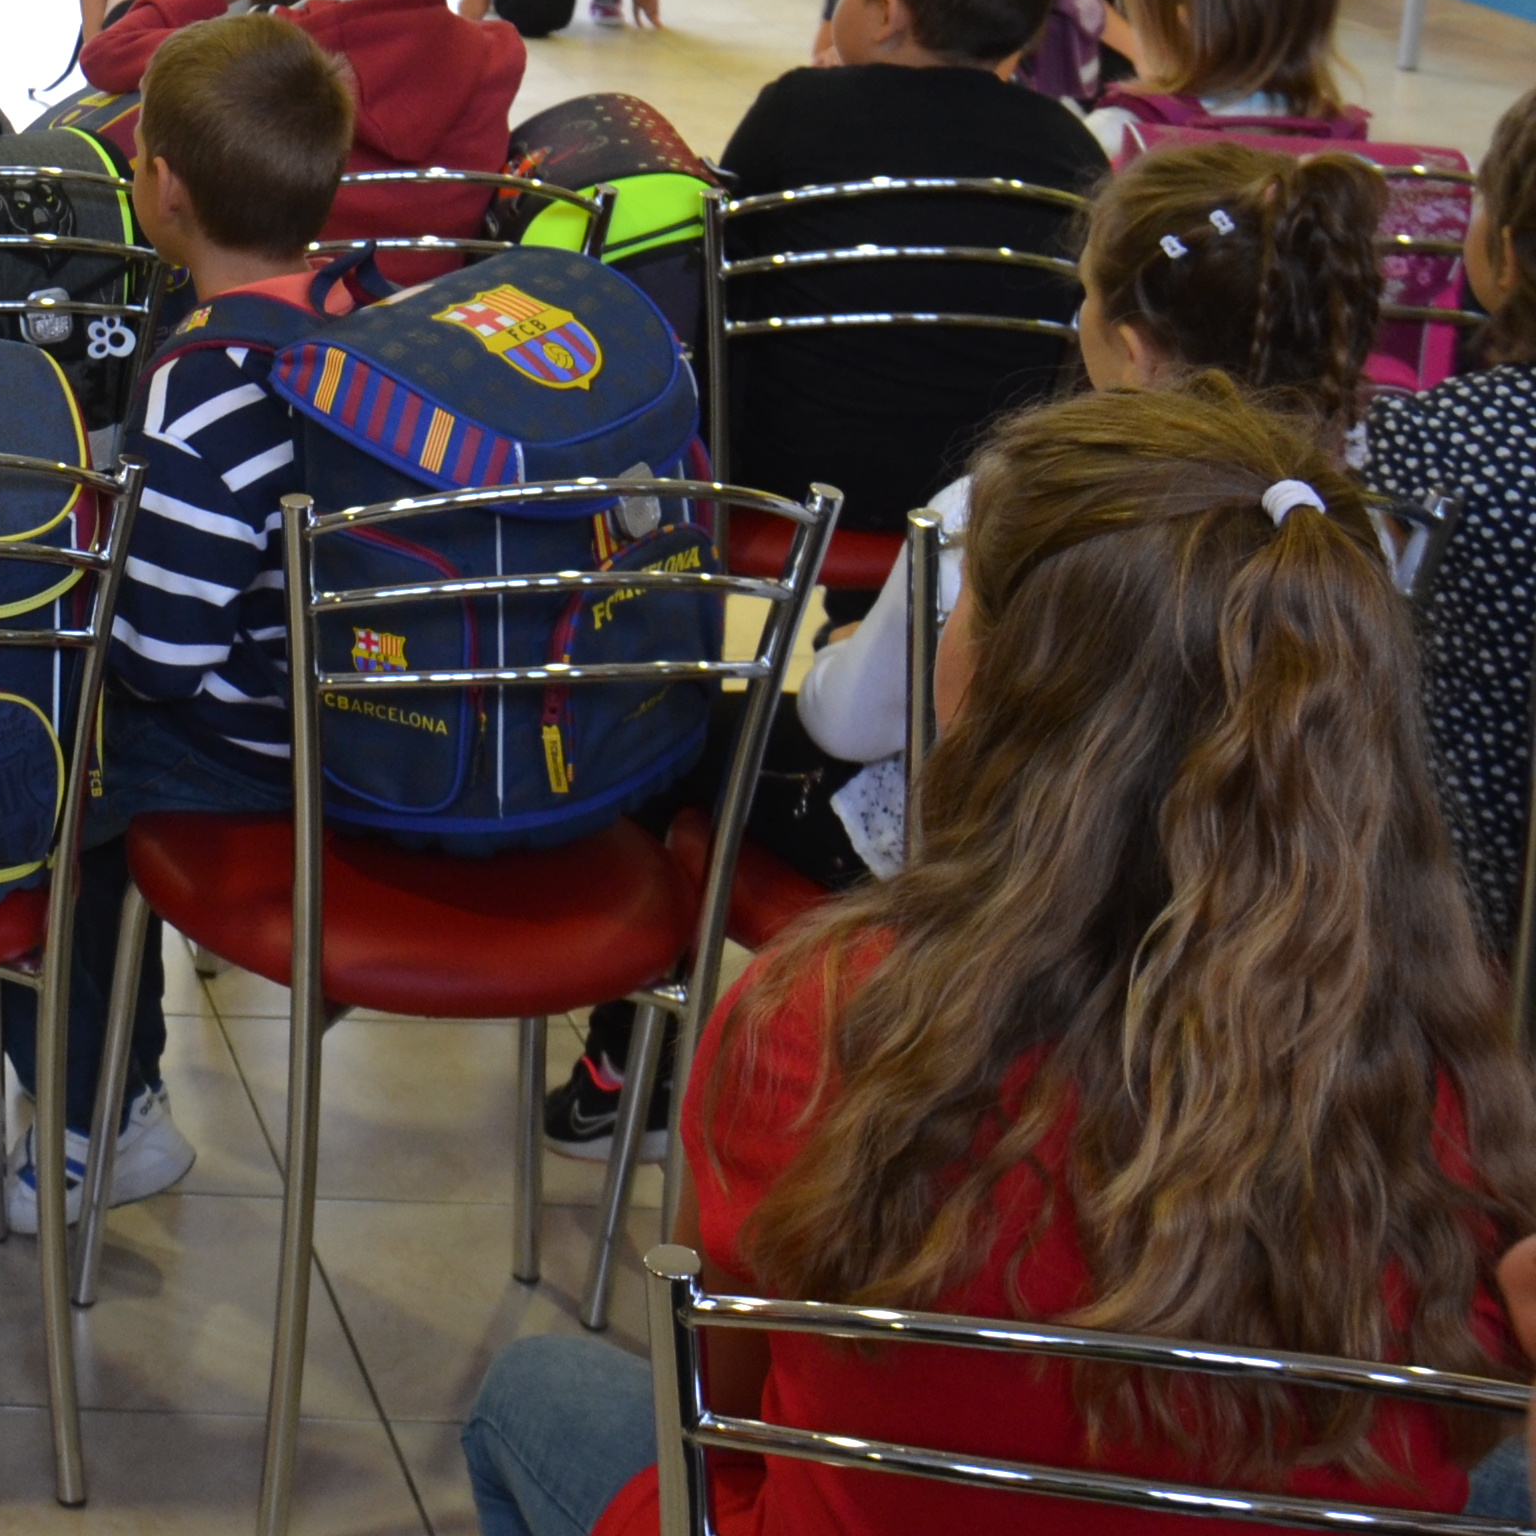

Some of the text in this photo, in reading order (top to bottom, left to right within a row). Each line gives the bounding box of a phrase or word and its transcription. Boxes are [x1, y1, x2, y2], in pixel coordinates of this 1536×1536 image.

[506, 319, 547, 342] FCB
[323, 691, 448, 736] CBARCELONA
[89, 769, 103, 797] FCB
